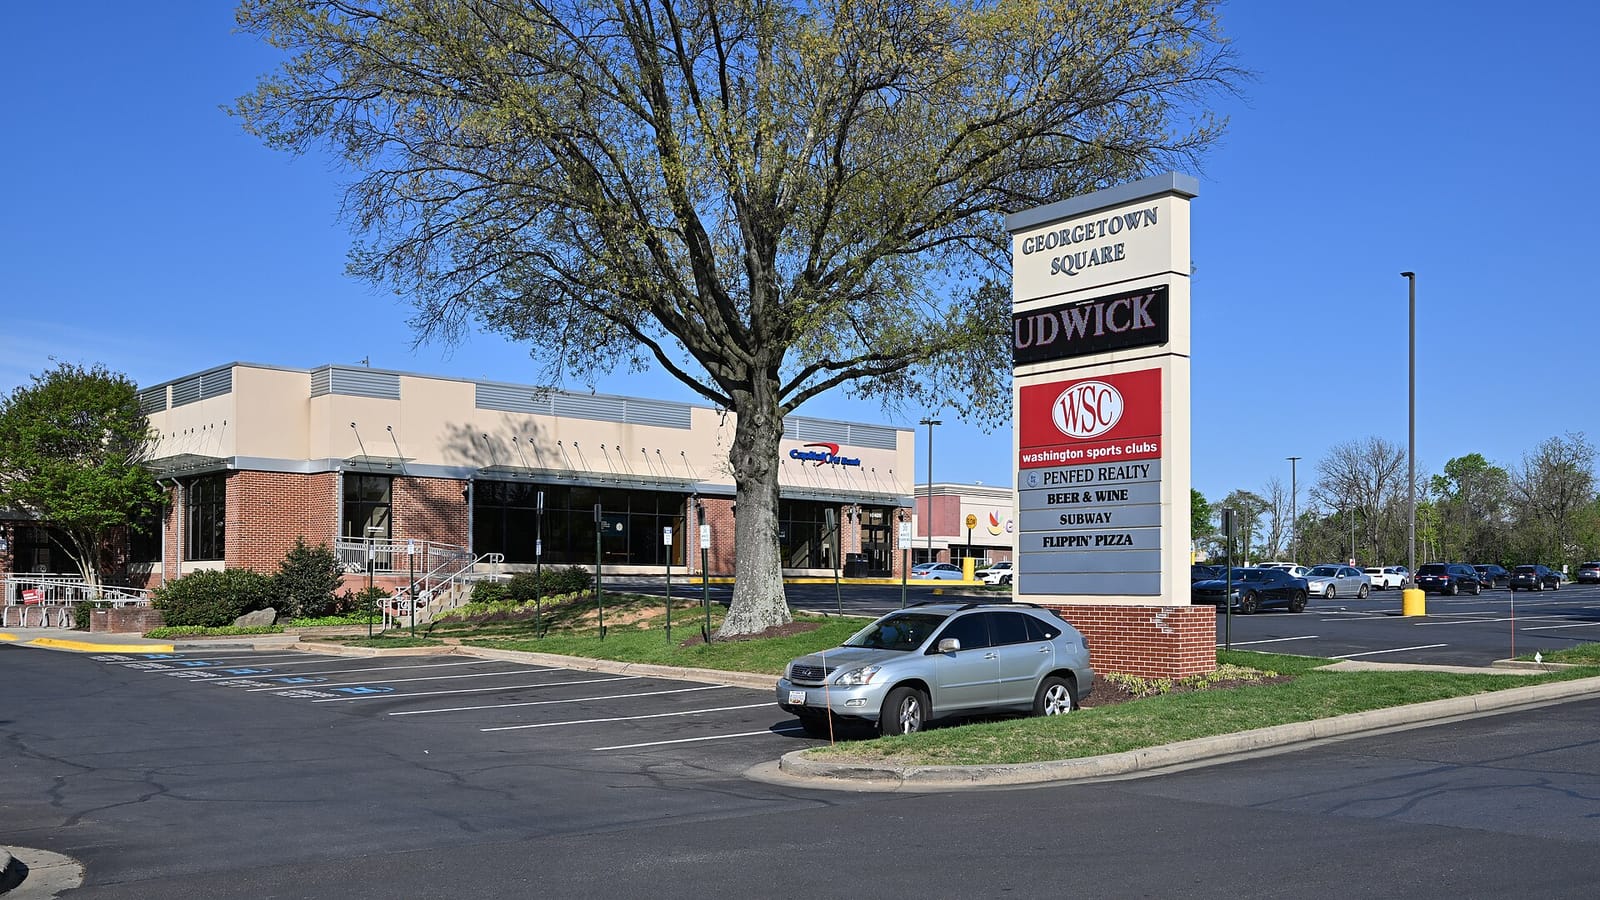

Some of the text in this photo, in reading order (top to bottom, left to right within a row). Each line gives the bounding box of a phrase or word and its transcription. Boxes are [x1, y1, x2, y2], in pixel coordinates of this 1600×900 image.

[1022, 206, 1158, 255] GEORGETOWN
[1050, 242, 1126, 276] SQUARE
[1015, 293, 1156, 349] UDWICK
[1060, 385, 1113, 434] WSC
[1022, 442, 1158, 463] washington sports clubs
[1043, 468, 1094, 486] PENFED
[1098, 464, 1150, 481] REALTY
[1047, 489, 1128, 505] BEER & WINE
[1059, 512, 1112, 526] SUBWAY
[1095, 534, 1133, 546] PIZZA
